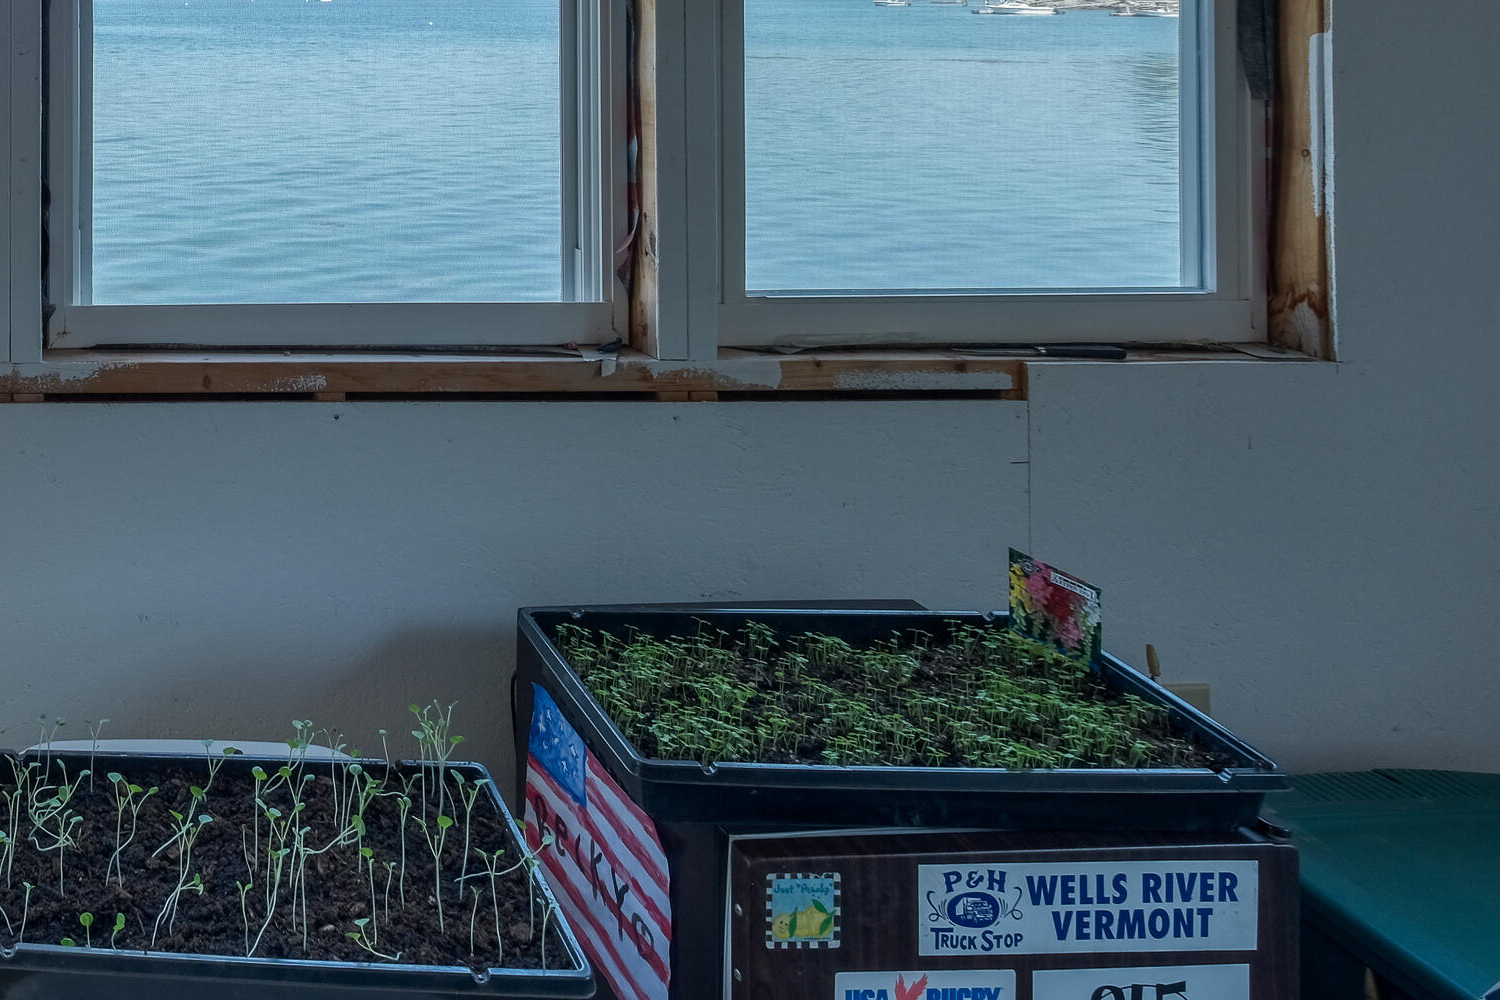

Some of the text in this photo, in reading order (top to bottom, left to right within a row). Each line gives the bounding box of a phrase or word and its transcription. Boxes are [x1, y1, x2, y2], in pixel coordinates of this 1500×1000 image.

[942, 869, 1007, 893] P&H
[1026, 871, 1238, 906] WELLS RIVER
[1052, 908, 1213, 940] VERMONT
[930, 927, 1024, 952] TRUCK STOP
